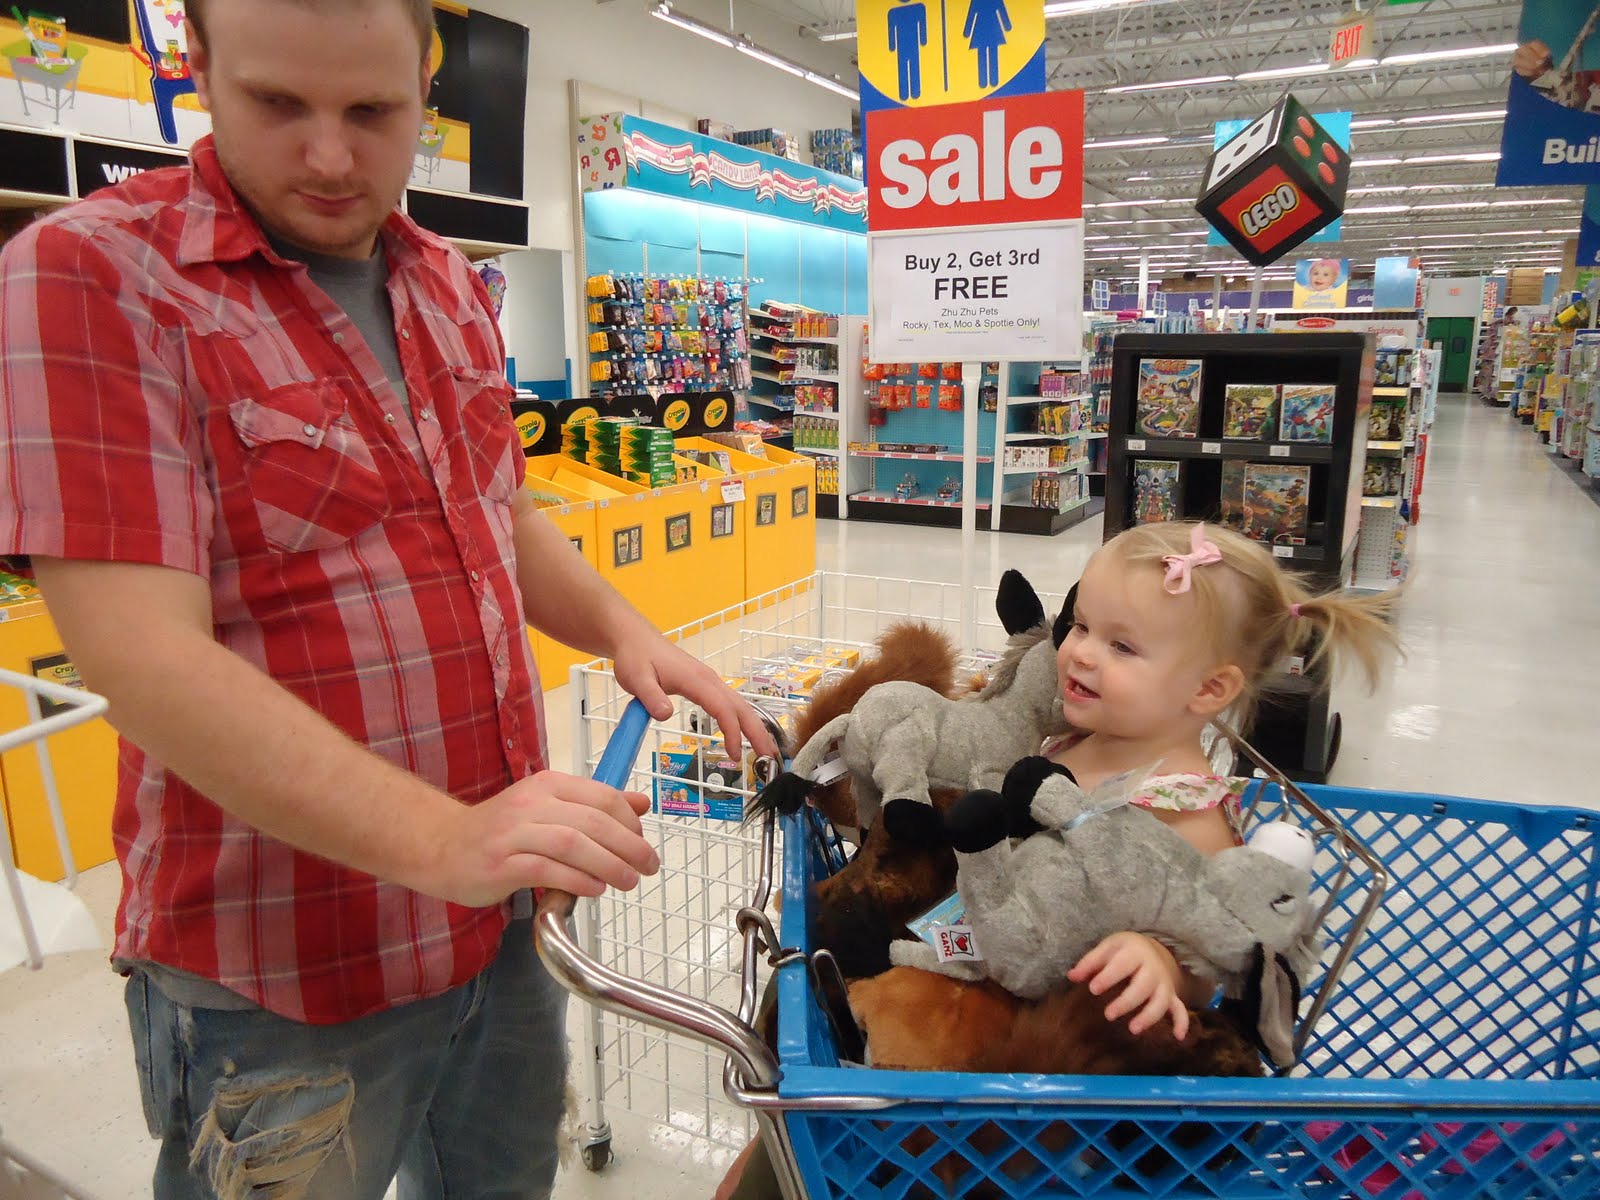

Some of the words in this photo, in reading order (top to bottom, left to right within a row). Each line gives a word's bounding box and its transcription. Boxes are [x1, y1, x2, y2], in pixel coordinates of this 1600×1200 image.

[1335, 25, 1362, 61] EXIT
[880, 110, 1063, 209] sale
[1241, 184, 1297, 236] LEGO
[905, 254, 941, 274] Buy
[947, 252, 962, 271] 2,
[969, 250, 1002, 268] Get
[1008, 248, 1040, 266] 3rd
[934, 275, 1008, 301] FREE
[903, 320, 931, 331] Rocky,
[933, 320, 952, 329] Tex,
[953, 320, 973, 328] Moo
[974, 319, 982, 328] &
[984, 318, 1015, 329] Spottie
[1016, 317, 1040, 329] Only!
[941, 308, 958, 317] Zhu
[960, 308, 977, 316] Zhu
[979, 307, 999, 316] Pets
[517, 419, 539, 433] rayola
[55, 665, 75, 675] Cray
[940, 931, 953, 957] GANZ
